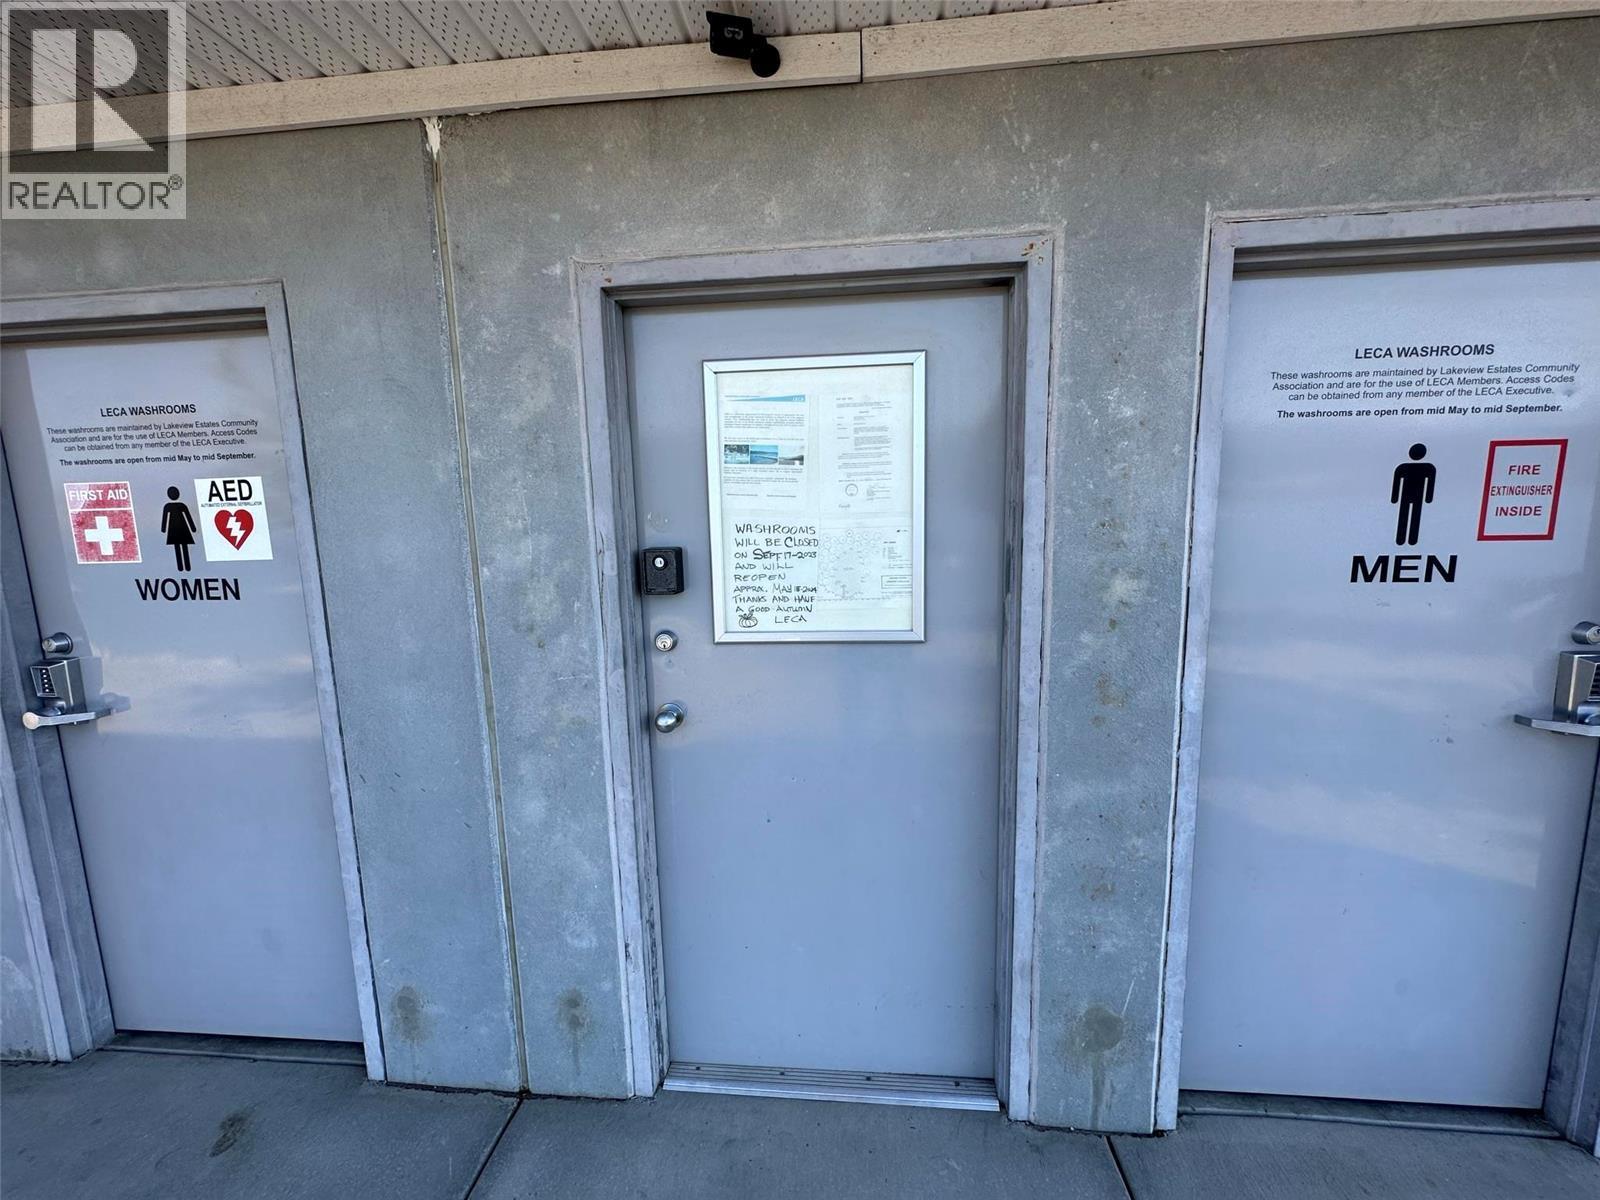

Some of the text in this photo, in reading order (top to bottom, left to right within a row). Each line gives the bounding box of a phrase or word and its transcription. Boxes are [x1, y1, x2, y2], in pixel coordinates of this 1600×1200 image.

[1354, 344, 1494, 360] LECA WASHROOMS
[1270, 372, 1298, 380] These
[1300, 370, 1352, 379] washrooms
[1372, 367, 1424, 378] maintained
[1426, 368, 1438, 378] by
[1440, 366, 1484, 375] Lakeview
[1486, 364, 1522, 374] Estates
[1525, 363, 1580, 374] Community
[1272, 382, 1324, 391] Association
[1326, 380, 1344, 389] and
[1363, 379, 1376, 388] for
[1379, 379, 1393, 388] the
[1396, 380, 1412, 388] use
[1415, 378, 1425, 386] of
[1426, 377, 1454, 387] LECA
[1457, 376, 1504, 386] Members.
[1506, 375, 1541, 384] Access
[1544, 374, 1575, 384] Codes
[1307, 391, 1319, 400] be
[1321, 390, 1360, 400] obtained
[1362, 390, 1384, 399] from
[1386, 390, 1403, 400] any
[1405, 388, 1443, 398] member
[1446, 387, 1456, 397] of
[1458, 387, 1472, 396] the
[1475, 386, 1503, 396] LECA
[1506, 385, 1555, 396] Executive.
[100, 404, 196, 418] LECA WASHROOMS
[1276, 404, 1563, 418] The washrooms are open from mid May to mid September.
[68, 426, 104, 434] washrooms
[117, 424, 152, 432] maintained
[154, 423, 162, 431] by
[195, 420, 220, 428] Estates
[220, 418, 258, 428] Community
[51, 436, 87, 444] Association
[144, 440, 171, 448] member
[192, 438, 212, 446] LECA
[126, 457, 144, 465] open
[178, 454, 192, 462] May
[216, 452, 256, 460] September.
[1508, 464, 1542, 476] FIRE
[68, 488, 128, 500] FIRST AID
[208, 479, 252, 502] AED
[1490, 484, 1553, 497] EXTINGUISHER
[1495, 505, 1542, 517] INSIDE
[735, 524, 816, 534] WASHROOMS
[734, 536, 818, 548] WILL BE CLOSED
[1350, 554, 1458, 583] MEN
[734, 573, 786, 582] REOPEN
[135, 578, 240, 601] WOMEN
[772, 584, 792, 594] MAY
[732, 594, 767, 603] THANKS
[775, 615, 807, 623] LECA
